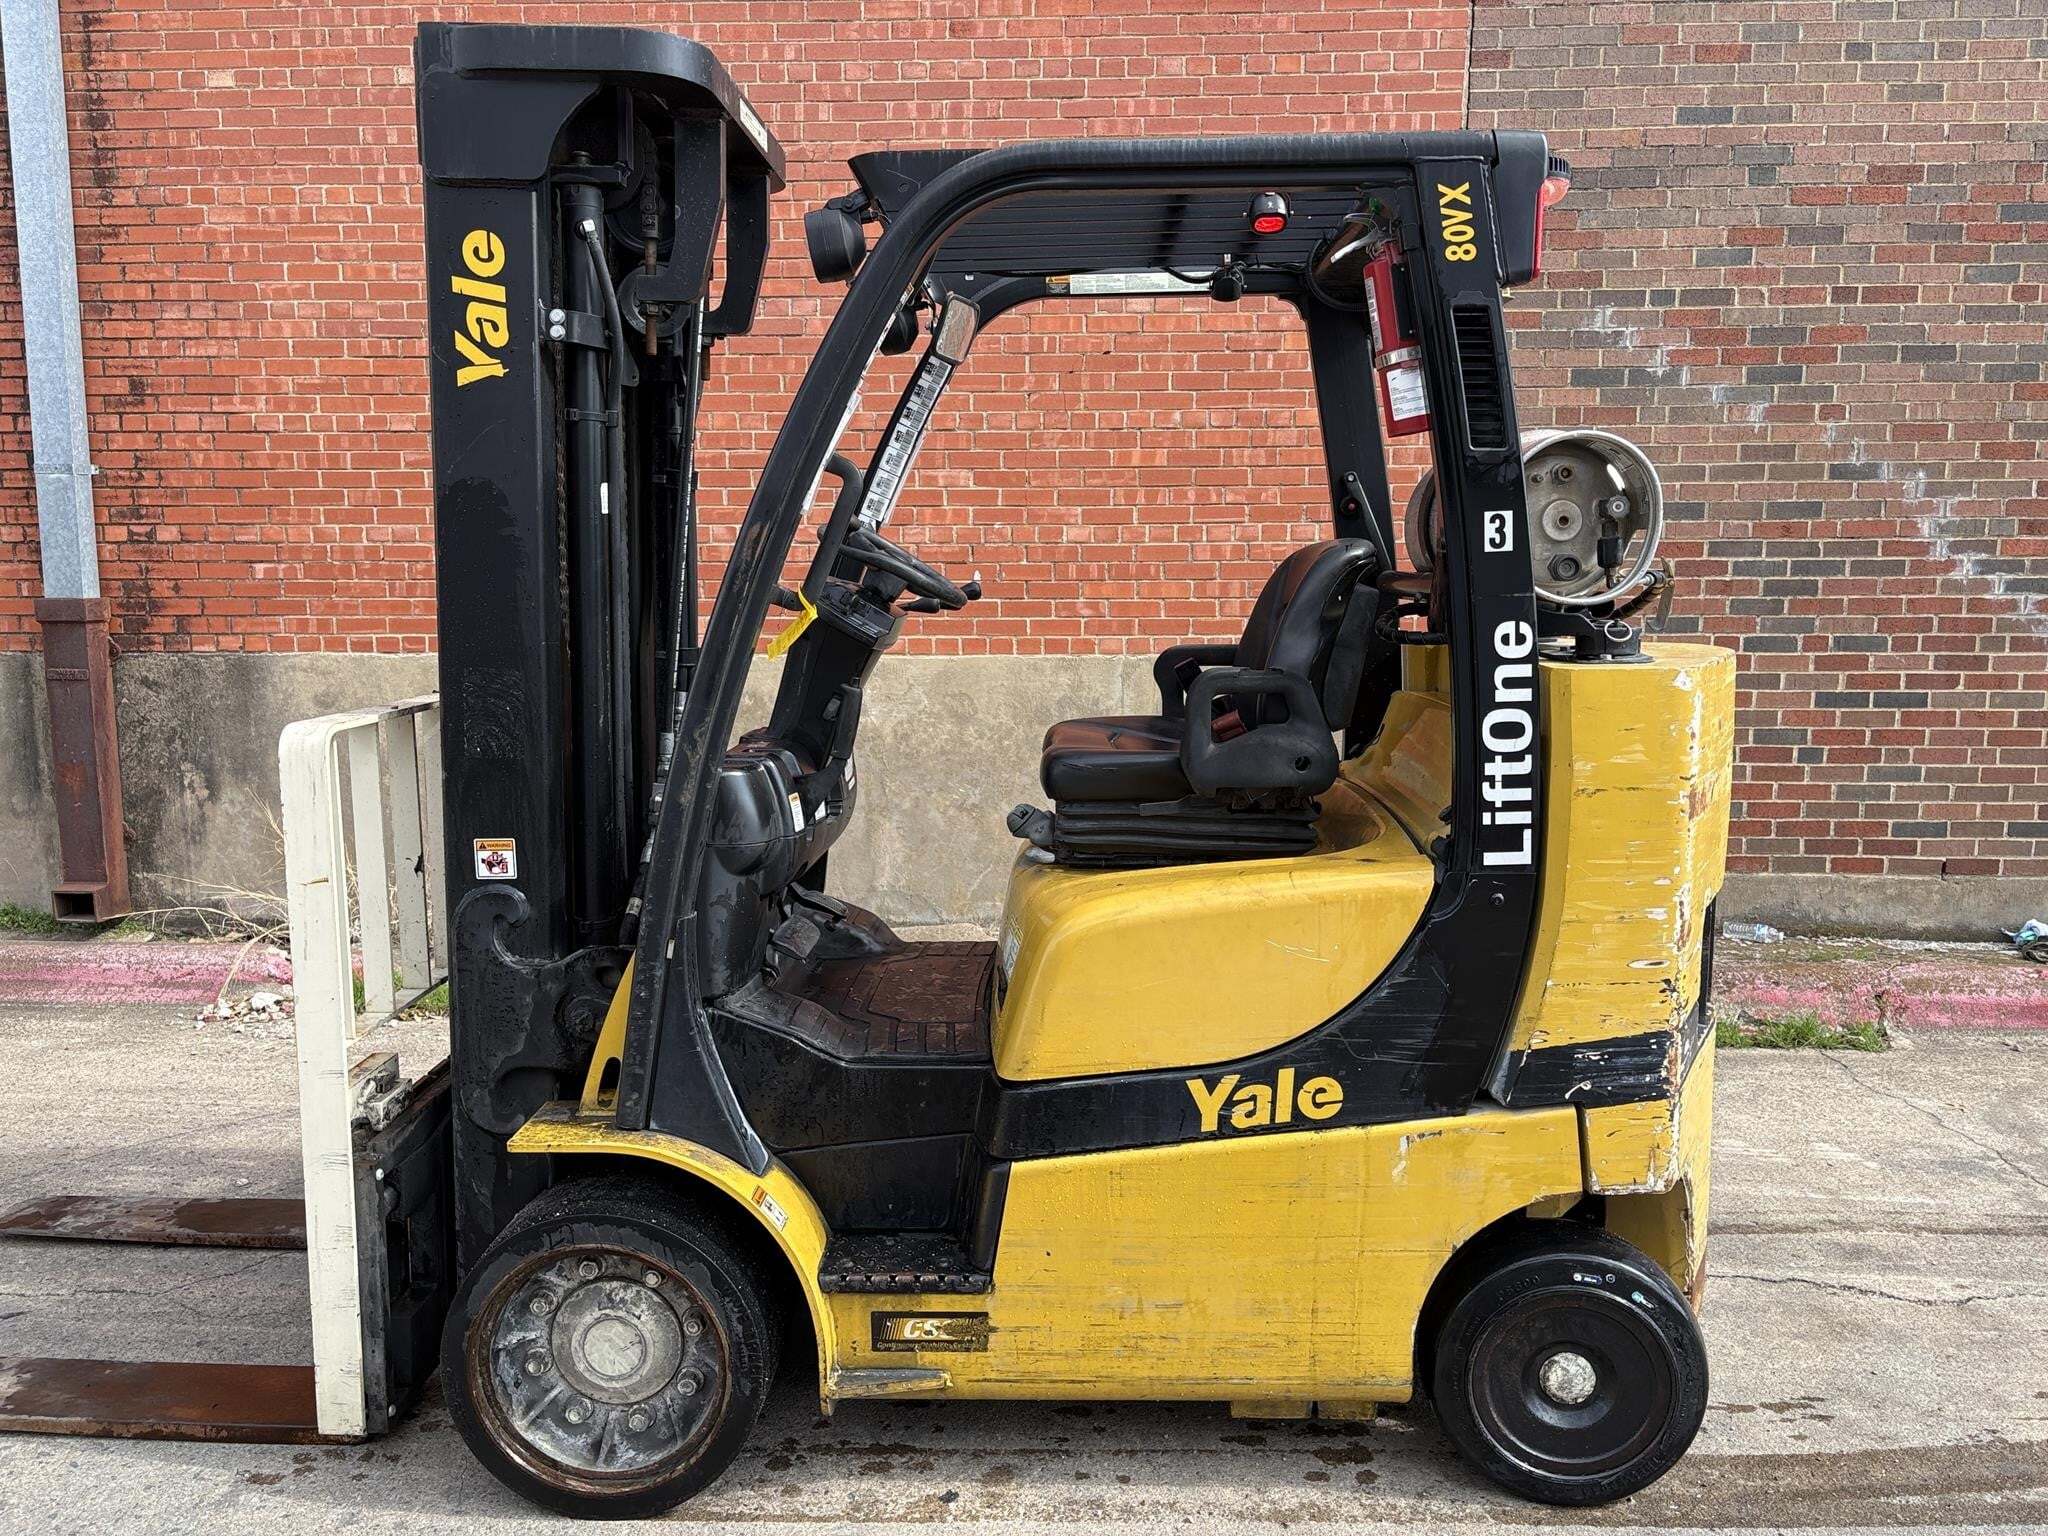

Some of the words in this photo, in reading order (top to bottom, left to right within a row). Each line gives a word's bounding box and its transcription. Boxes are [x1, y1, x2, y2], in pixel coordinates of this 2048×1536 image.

[1437, 183, 1477, 262] 80VX
[451, 229, 508, 387] Yale
[1489, 513, 1506, 549] 3
[1482, 620, 1534, 866] LiftOne
[1185, 1067, 1344, 1133] Yale
